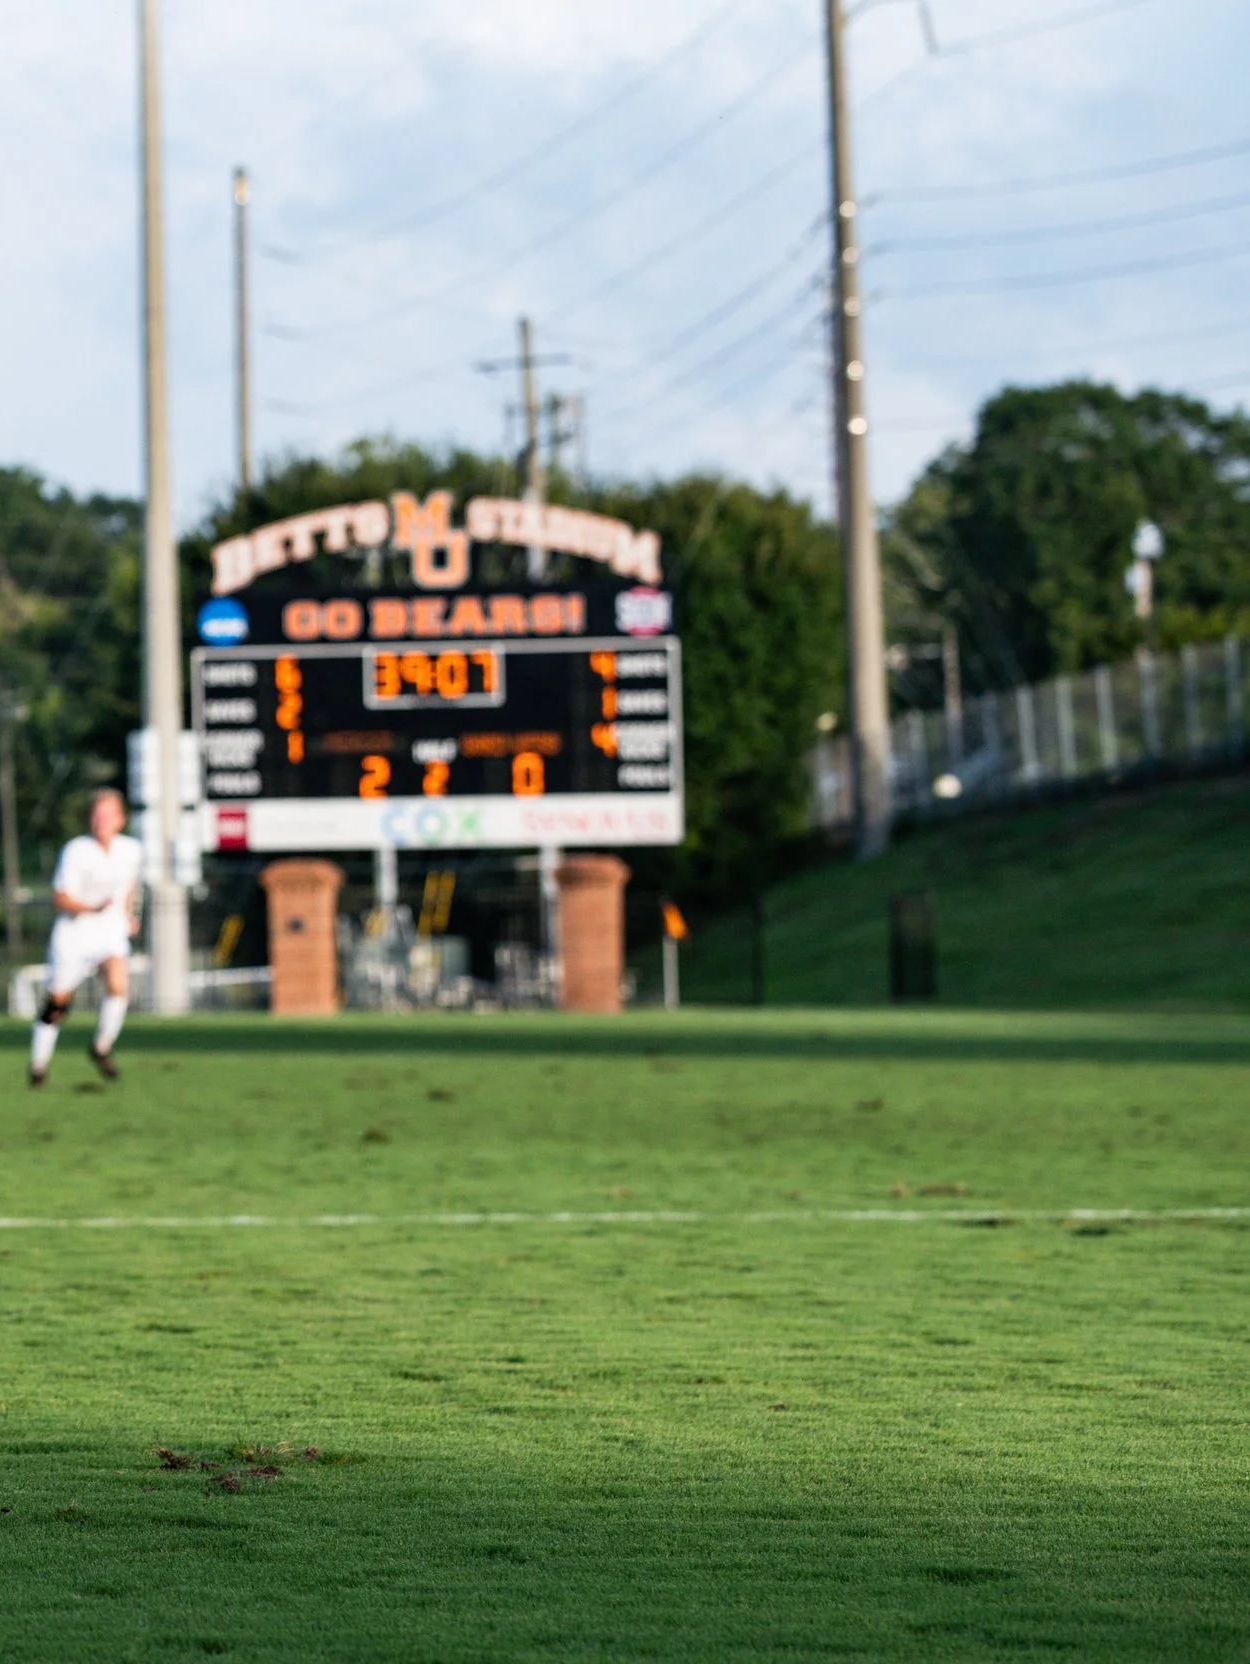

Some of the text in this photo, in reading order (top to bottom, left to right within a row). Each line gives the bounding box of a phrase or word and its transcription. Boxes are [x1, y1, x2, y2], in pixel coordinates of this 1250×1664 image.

[283, 599, 363, 641] GO
[368, 594, 585, 638] BEARS!
[359, 755, 391, 799] 2
[512, 752, 545, 797] 0
[381, 802, 486, 846] COX
